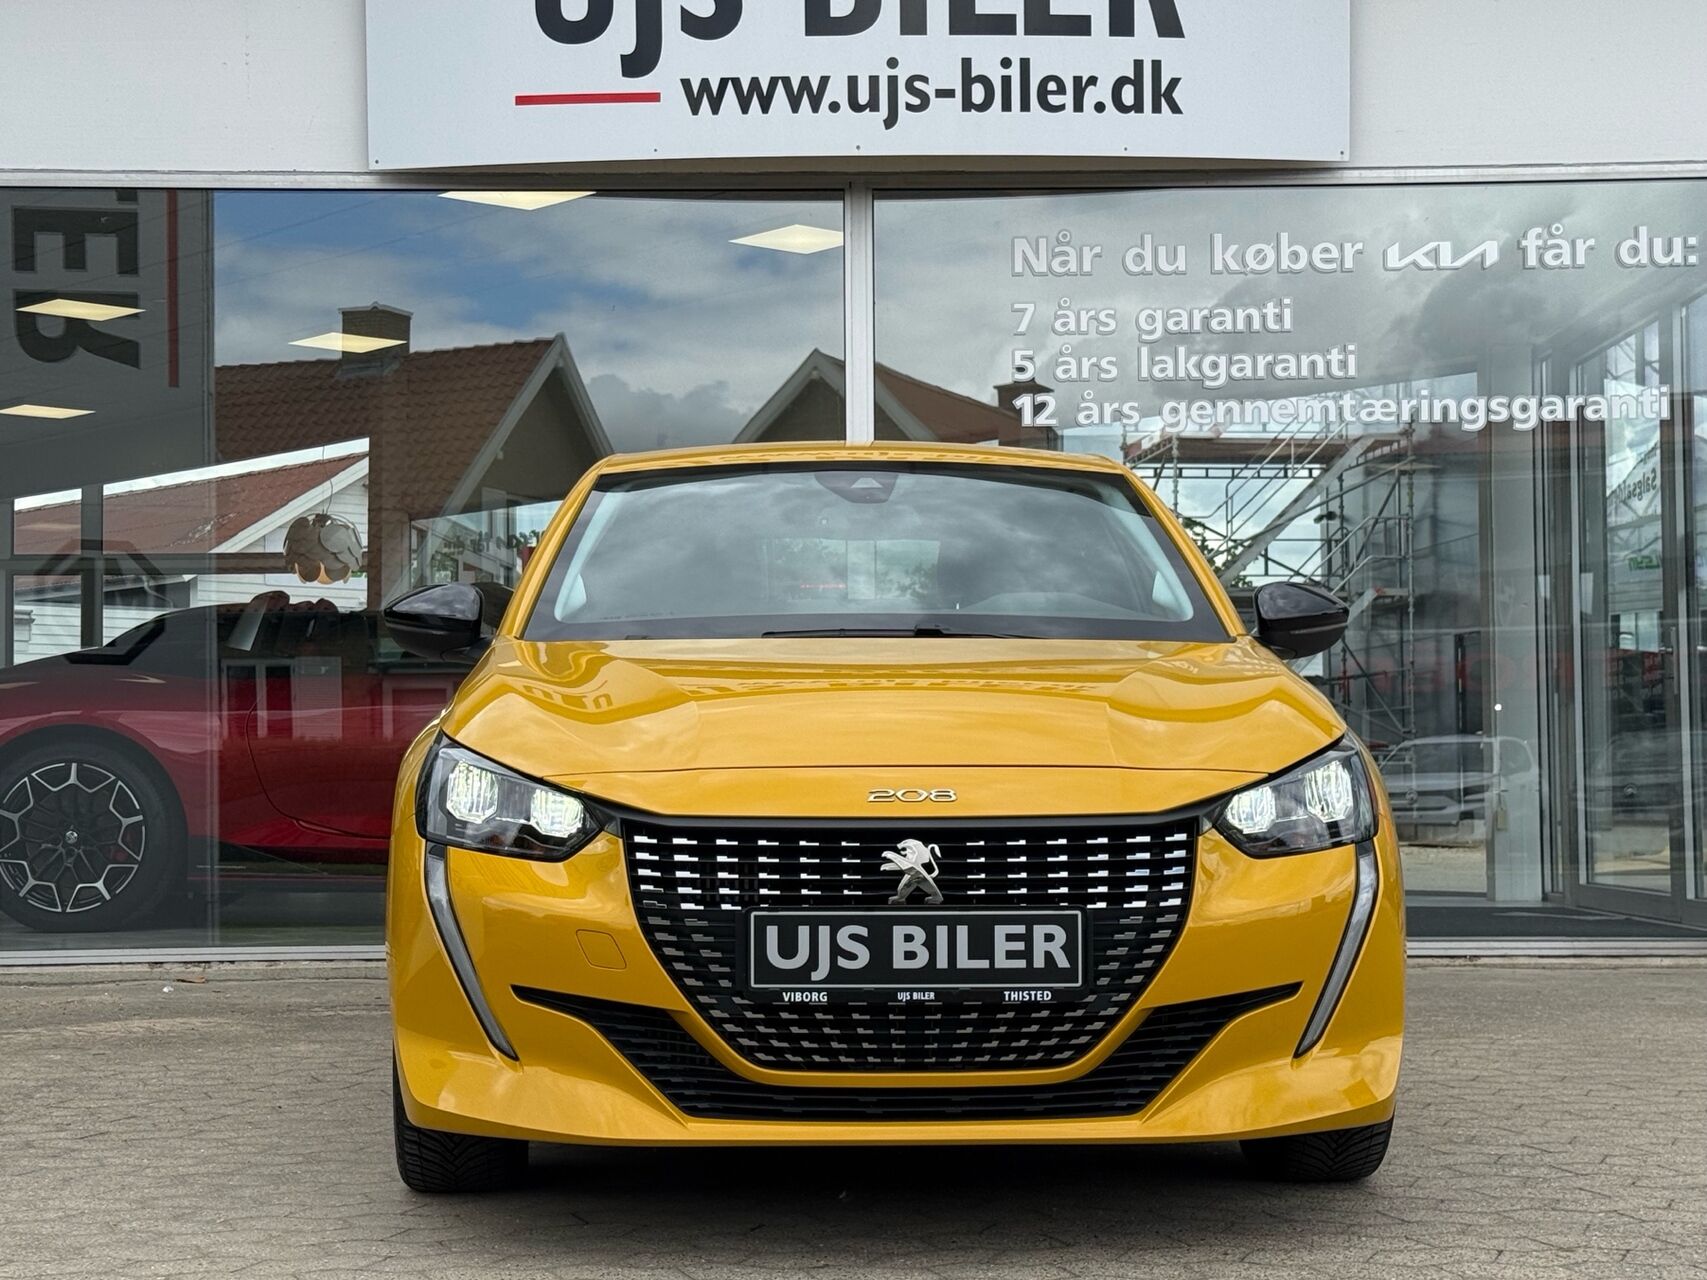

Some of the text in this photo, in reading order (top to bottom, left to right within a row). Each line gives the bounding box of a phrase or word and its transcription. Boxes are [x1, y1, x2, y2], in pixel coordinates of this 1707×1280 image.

[680, 57, 1183, 130] www.ujs-biler.dk
[1012, 230, 1101, 276] Når
[1123, 234, 1187, 275] du
[1210, 232, 1363, 275] køber
[1519, 223, 1595, 269] får
[1615, 226, 1698, 268] du:
[1011, 297, 1294, 343] 7 års garanti
[1011, 344, 1357, 388] 5 års lakgaranti
[1012, 384, 1671, 432] 12 års gennemtæringsgaranti
[867, 789, 958, 802] 208
[766, 925, 1071, 981] UJS BILER
[782, 991, 828, 1002] VIBORG
[897, 991, 935, 1002] UJS BILER
[1003, 990, 1052, 1001] THISTED
